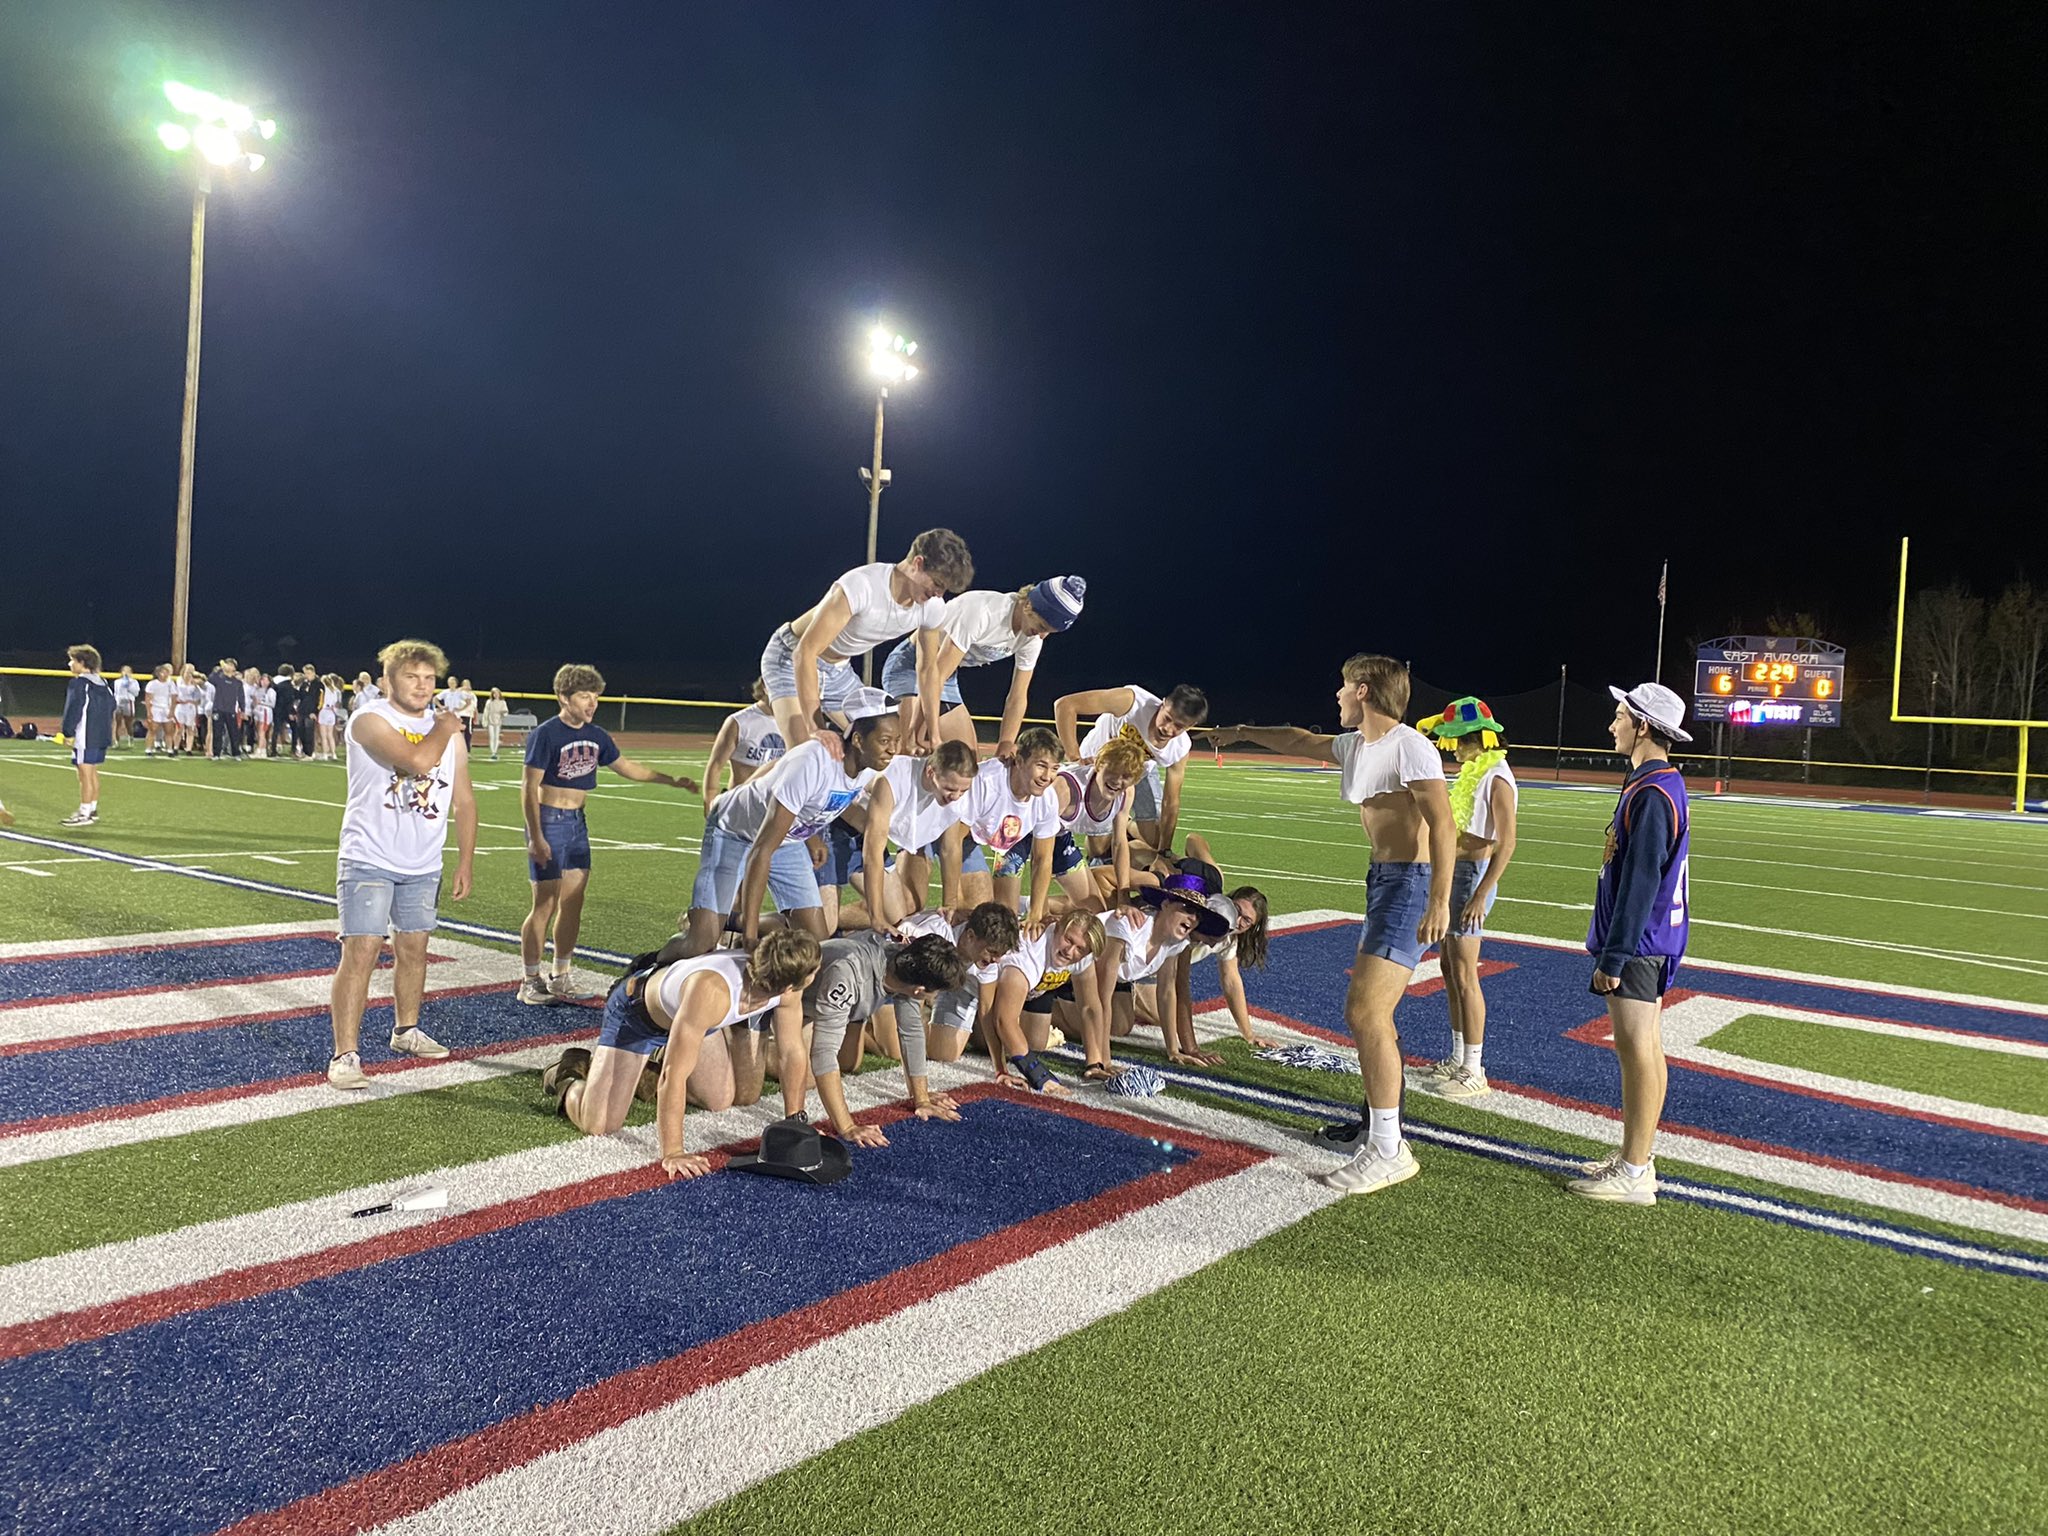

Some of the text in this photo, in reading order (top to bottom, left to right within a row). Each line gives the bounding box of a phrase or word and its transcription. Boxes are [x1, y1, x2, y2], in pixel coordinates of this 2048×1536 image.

[1722, 650, 1820, 665] EAST AURORA
[1708, 665, 1734, 675] HOME
[1803, 669, 1833, 679] GUEST
[1718, 674, 1733, 692] 6
[1747, 685, 1769, 693] PERIOD
[1816, 678, 1831, 698] 0
[745, 746, 768, 762] EAST
